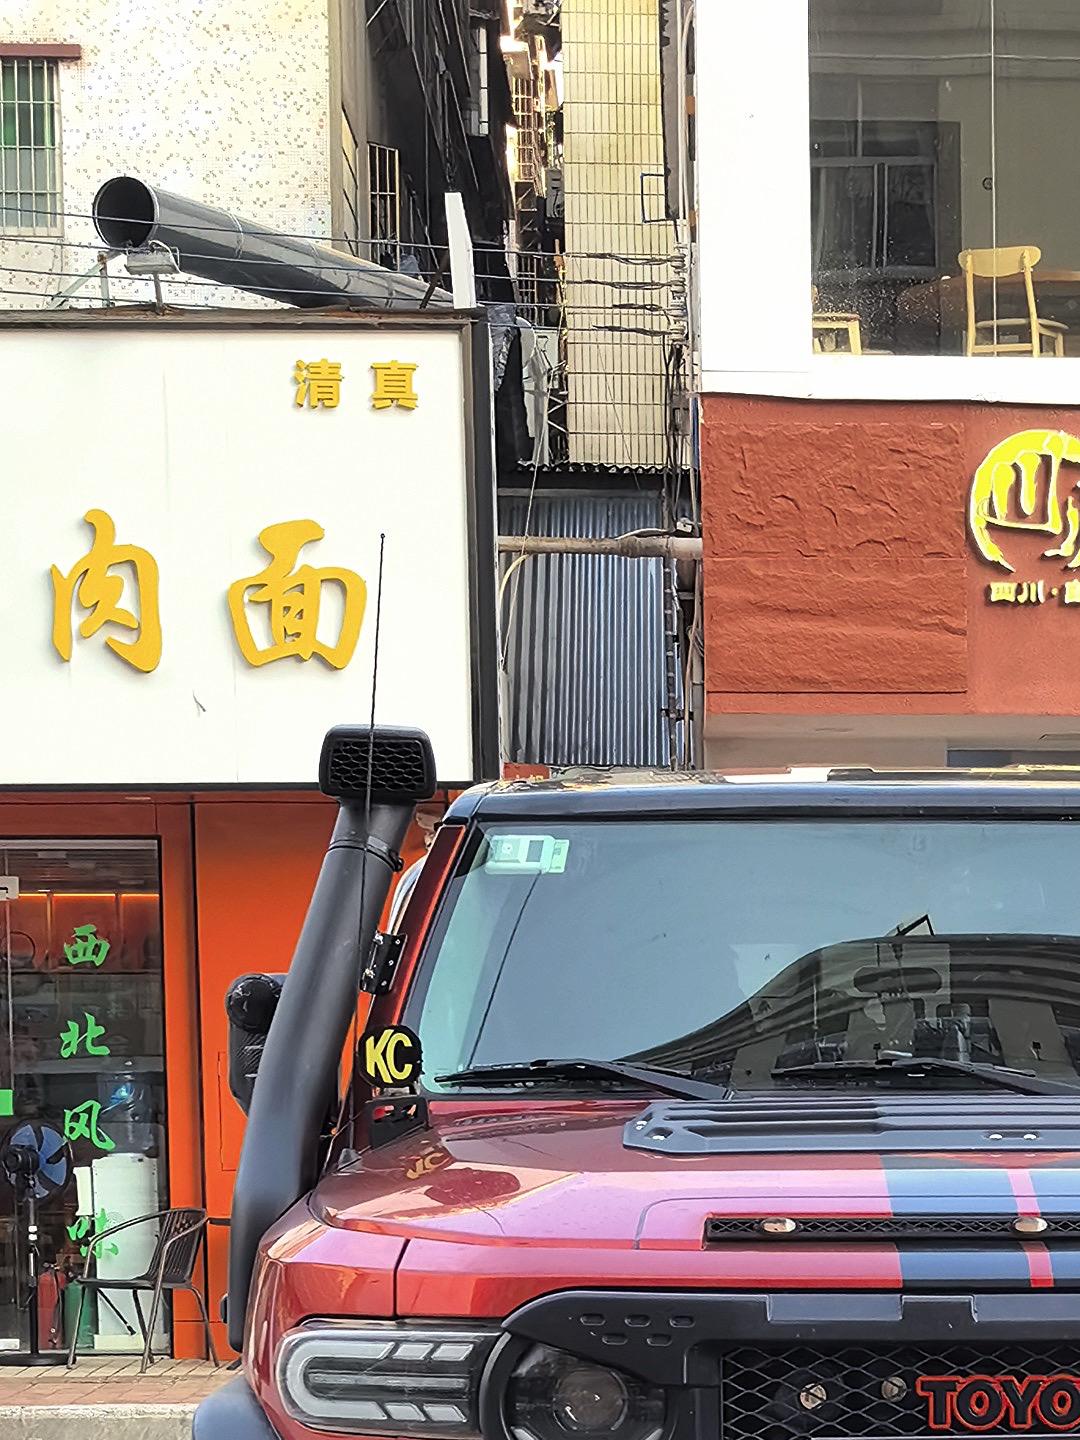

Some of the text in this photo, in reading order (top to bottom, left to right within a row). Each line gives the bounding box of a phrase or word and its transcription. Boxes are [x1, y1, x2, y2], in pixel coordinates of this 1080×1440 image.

[294, 358, 420, 410] 清真
[51, 508, 368, 673] 肉面
[59, 923, 121, 1259] 西北风味
[365, 1032, 414, 1085] KC
